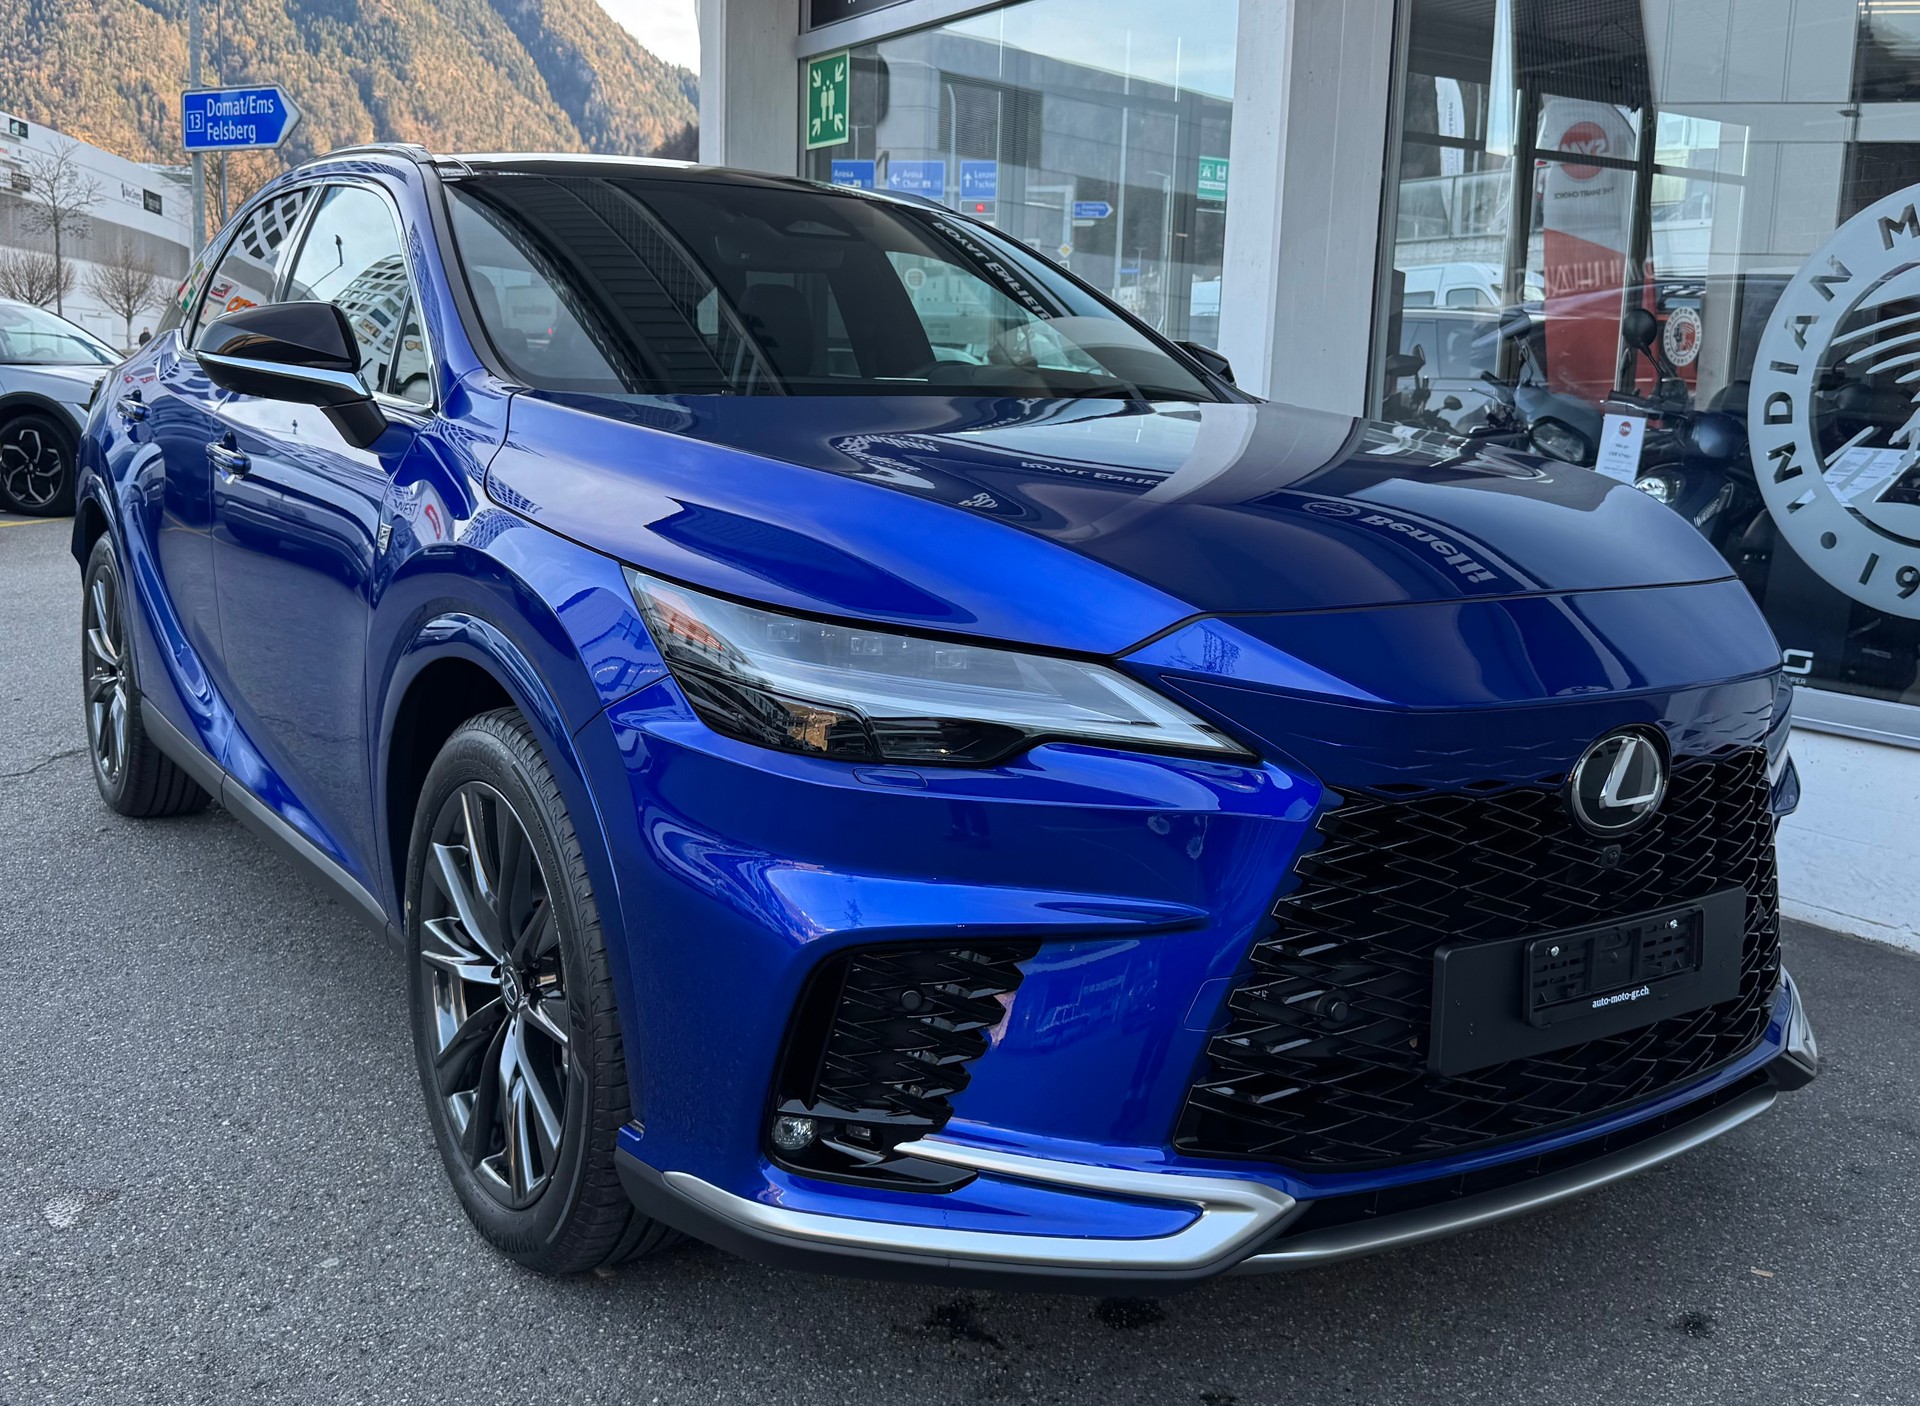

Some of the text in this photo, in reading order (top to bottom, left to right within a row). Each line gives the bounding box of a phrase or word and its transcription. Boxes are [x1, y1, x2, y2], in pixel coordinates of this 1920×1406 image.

[206, 95, 275, 118] Domat/Ems
[189, 113, 201, 129] 13
[206, 120, 257, 144] Felsberg
[1763, 254, 1853, 514] INDIAN
[1591, 985, 1650, 1008] auto-moto-gr.ch
